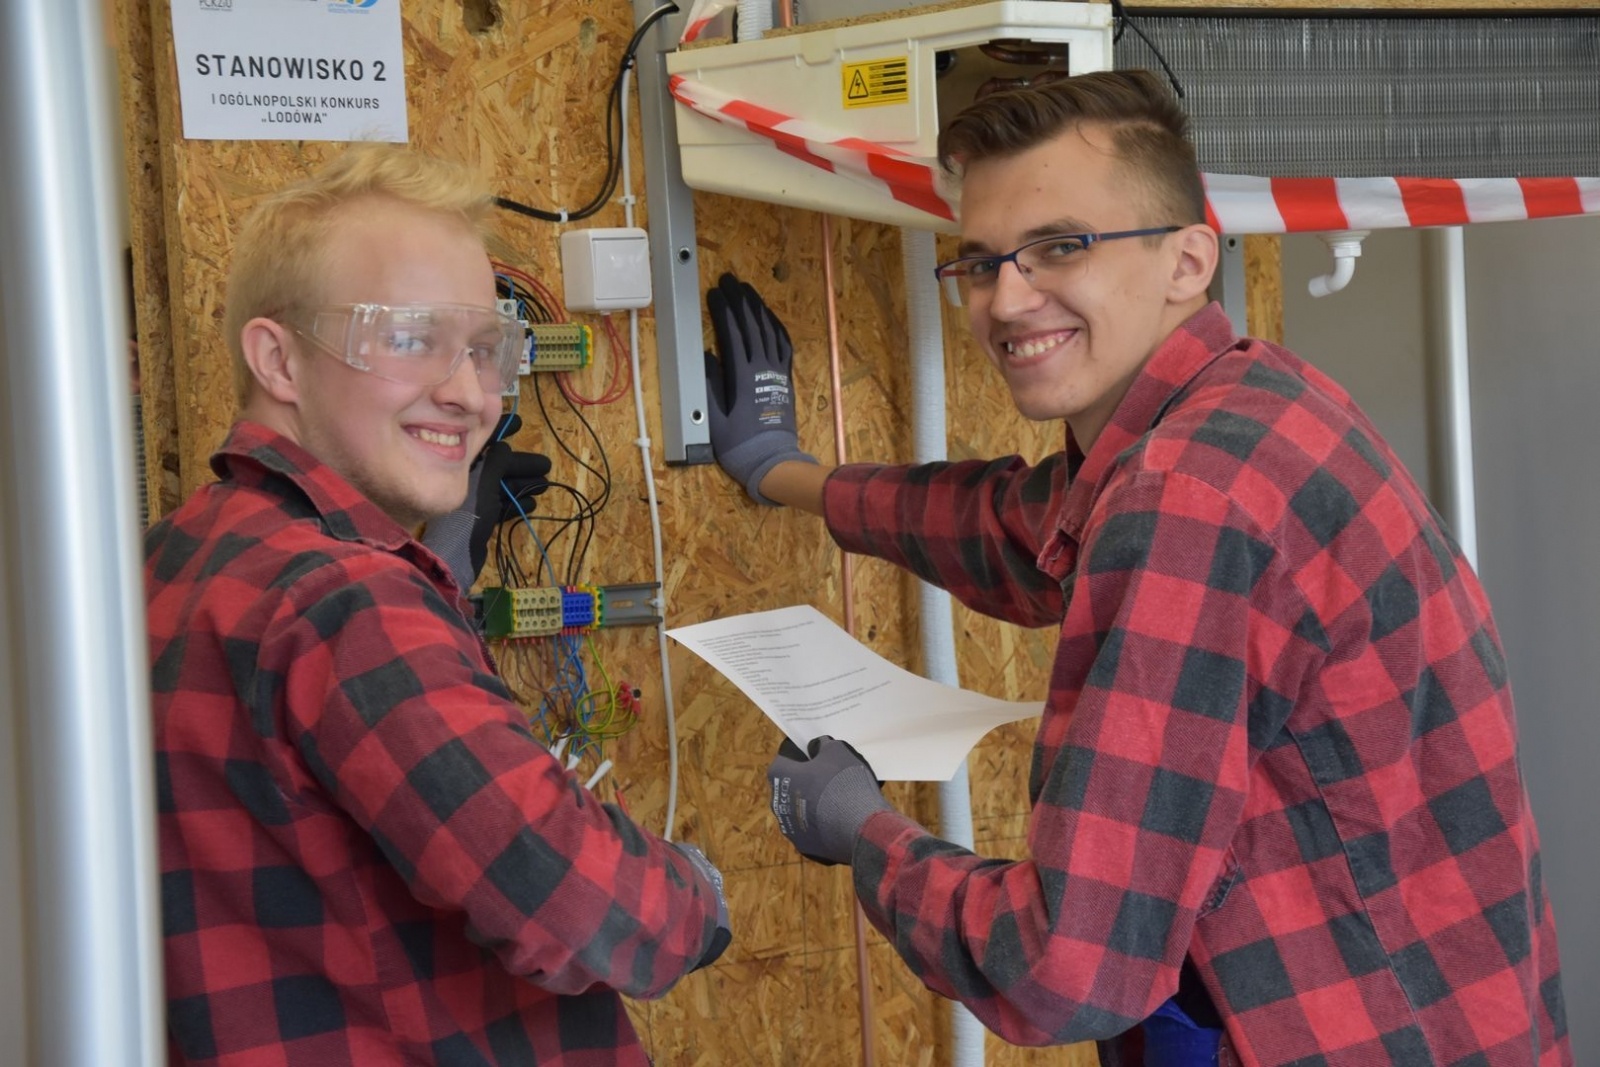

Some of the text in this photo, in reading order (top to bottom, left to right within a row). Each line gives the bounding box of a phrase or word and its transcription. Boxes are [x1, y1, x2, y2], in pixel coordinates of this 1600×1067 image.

[196, 53, 387, 82] STANOWISKO 2
[211, 91, 380, 109] I OGÓLNOPOLSKI KONKURS
